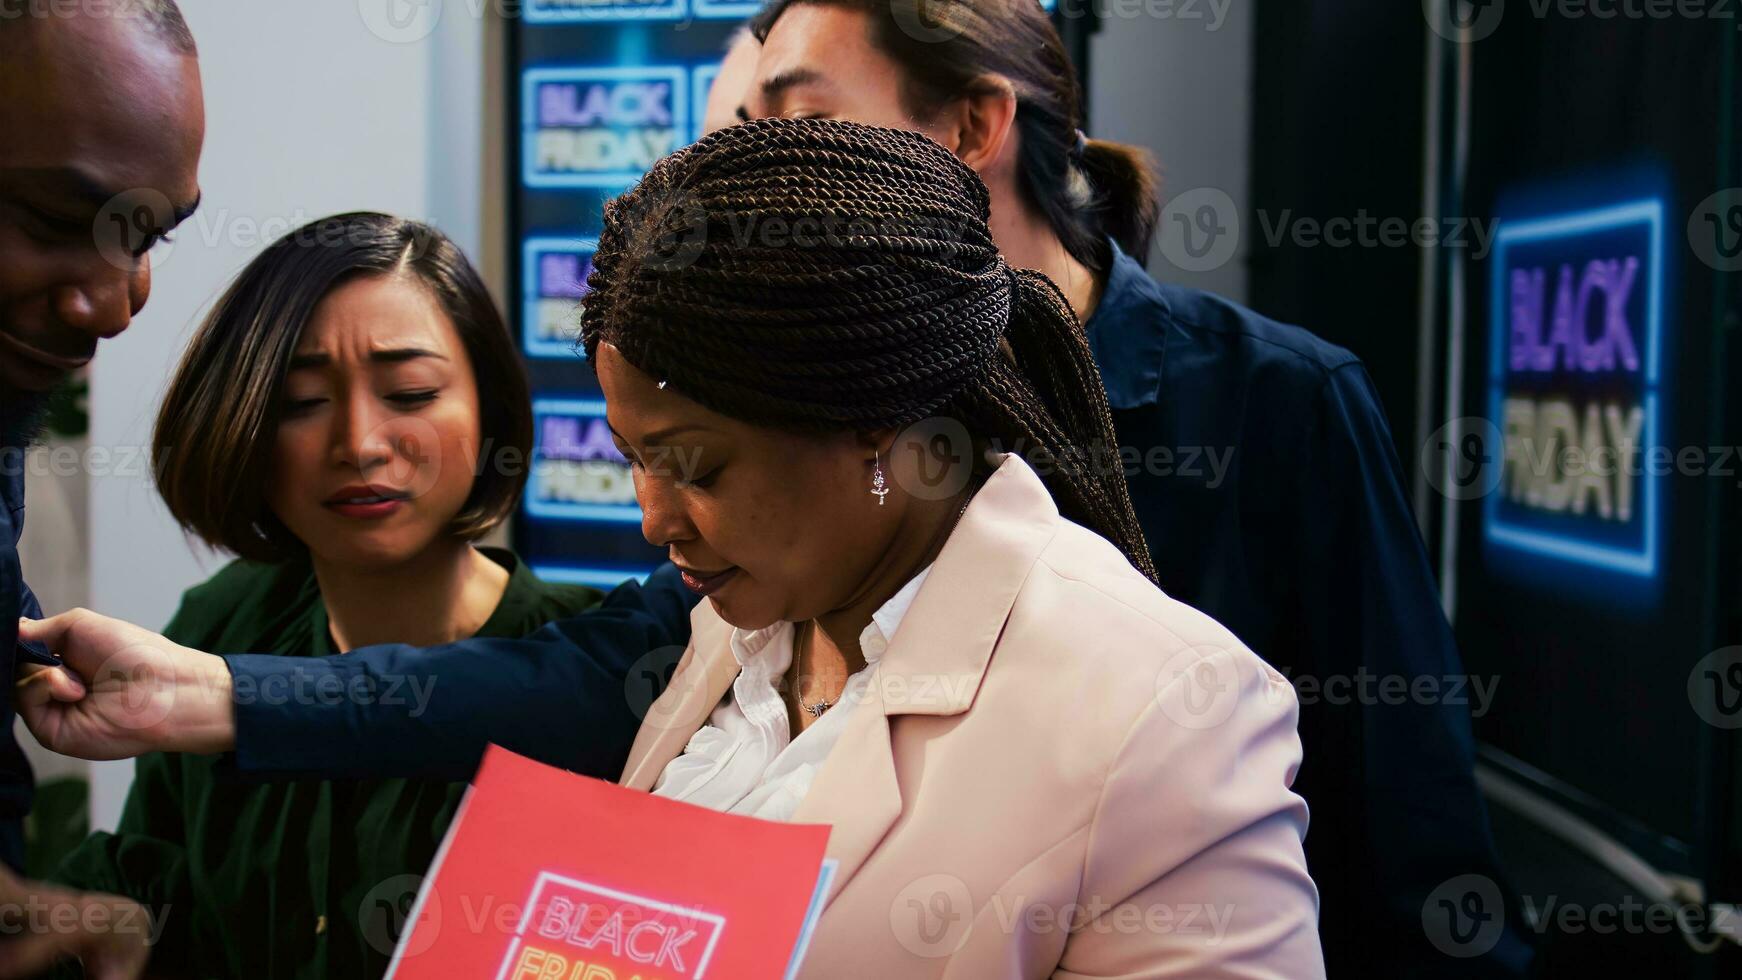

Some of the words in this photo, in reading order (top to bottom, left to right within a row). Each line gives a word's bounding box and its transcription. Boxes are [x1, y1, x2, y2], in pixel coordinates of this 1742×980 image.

[540, 82, 671, 127] BLACK
[1510, 256, 1640, 372] BLACK
[1503, 397, 1645, 522] FRIDAY
[538, 895, 697, 973] BLACK
